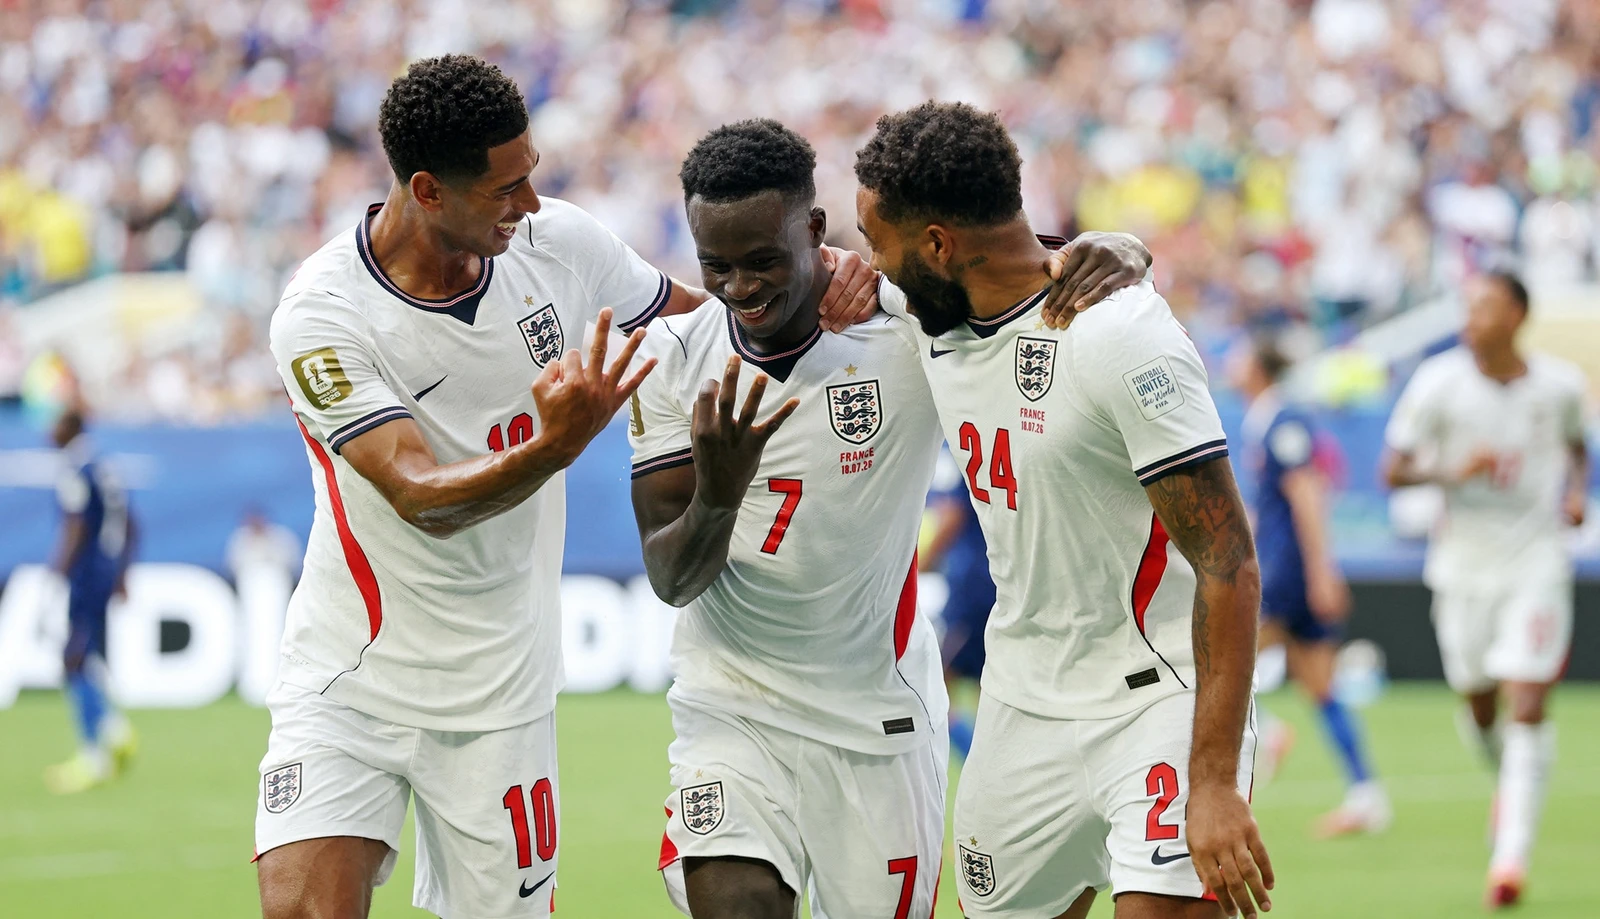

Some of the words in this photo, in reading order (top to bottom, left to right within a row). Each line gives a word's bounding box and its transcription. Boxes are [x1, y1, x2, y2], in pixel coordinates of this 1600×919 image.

[1132, 365, 1165, 386] FOOTBALL
[1136, 373, 1170, 397] UNITES
[319, 390, 342, 405] 2026
[1141, 397, 1155, 408] the
[1153, 384, 1175, 401] World
[1155, 400, 1169, 409] FIFA
[1020, 408, 1046, 422] FRANCE
[840, 447, 875, 463] FRANCE
[841, 459, 873, 475] 18.07.26
[959, 421, 1018, 511] 24
[760, 478, 803, 555] 7
[1145, 762, 1188, 841] 2
[503, 777, 557, 869] 10
[887, 855, 918, 919] 7
